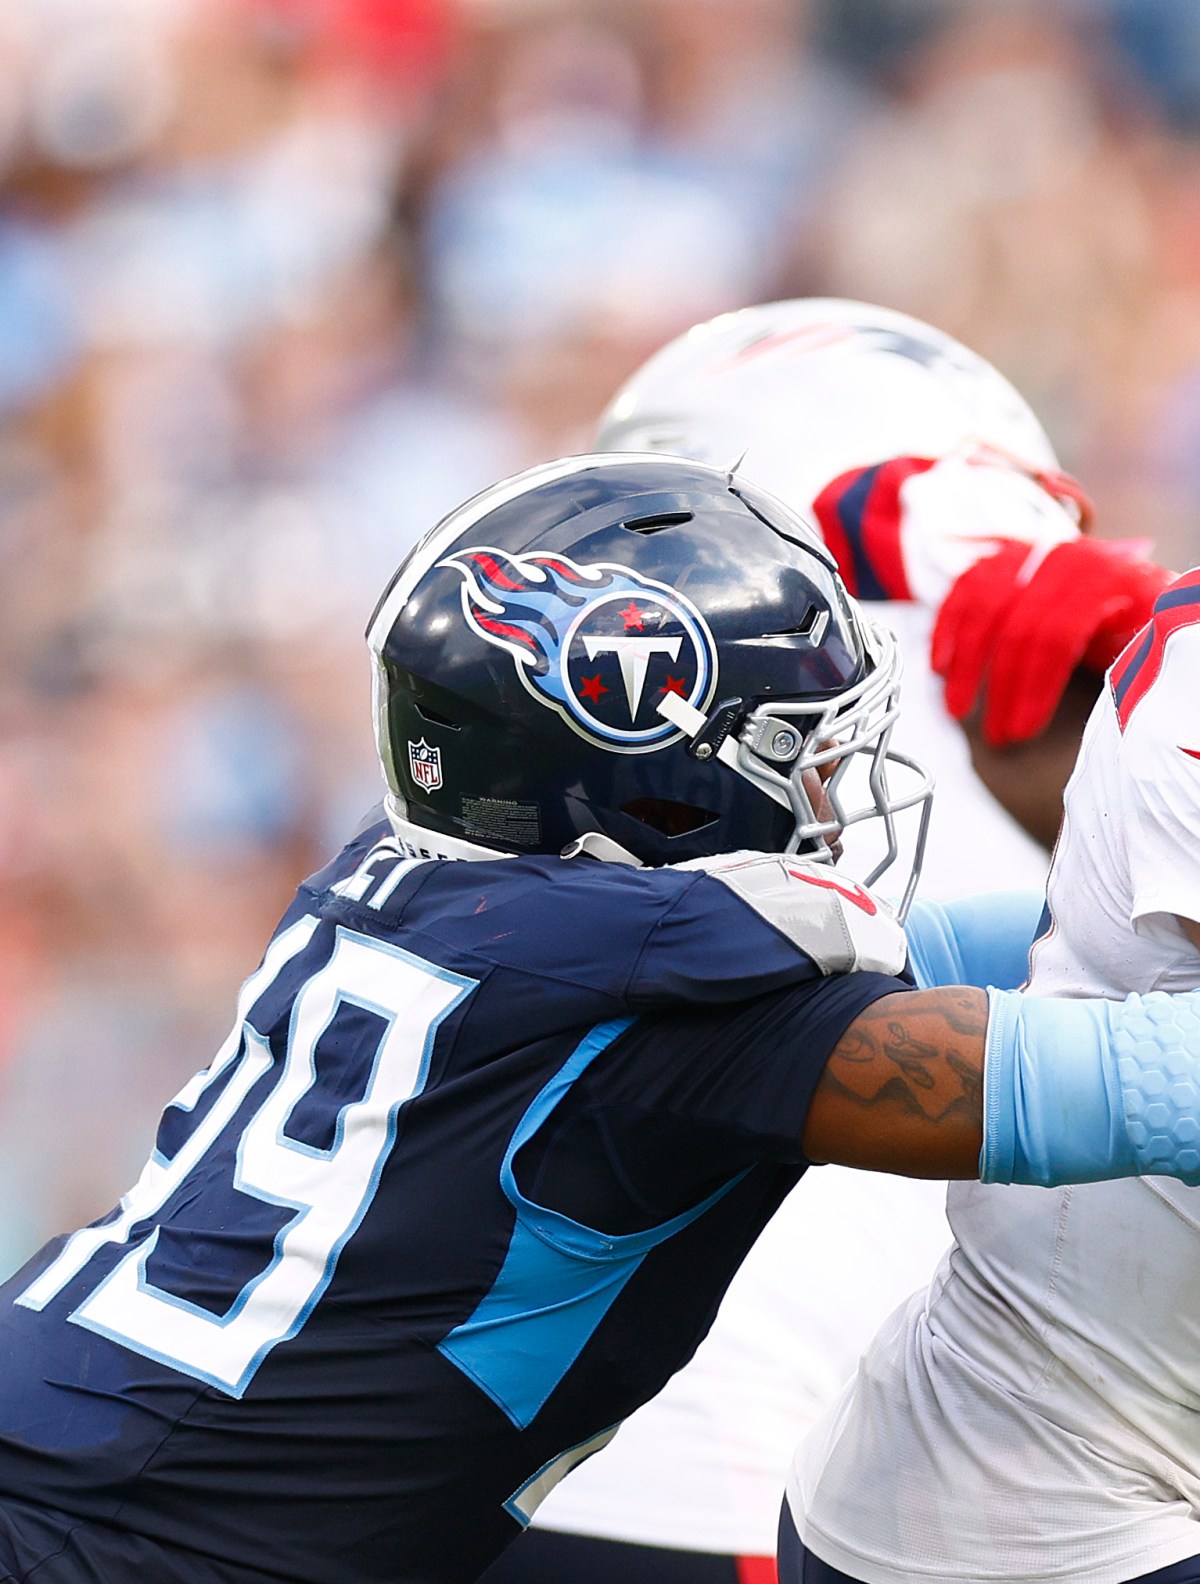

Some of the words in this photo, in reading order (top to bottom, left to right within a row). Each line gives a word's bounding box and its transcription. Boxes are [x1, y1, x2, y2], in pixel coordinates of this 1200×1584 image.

[581, 636, 684, 724] T
[414, 760, 440, 785] NFL
[479, 797, 518, 806] WARNING
